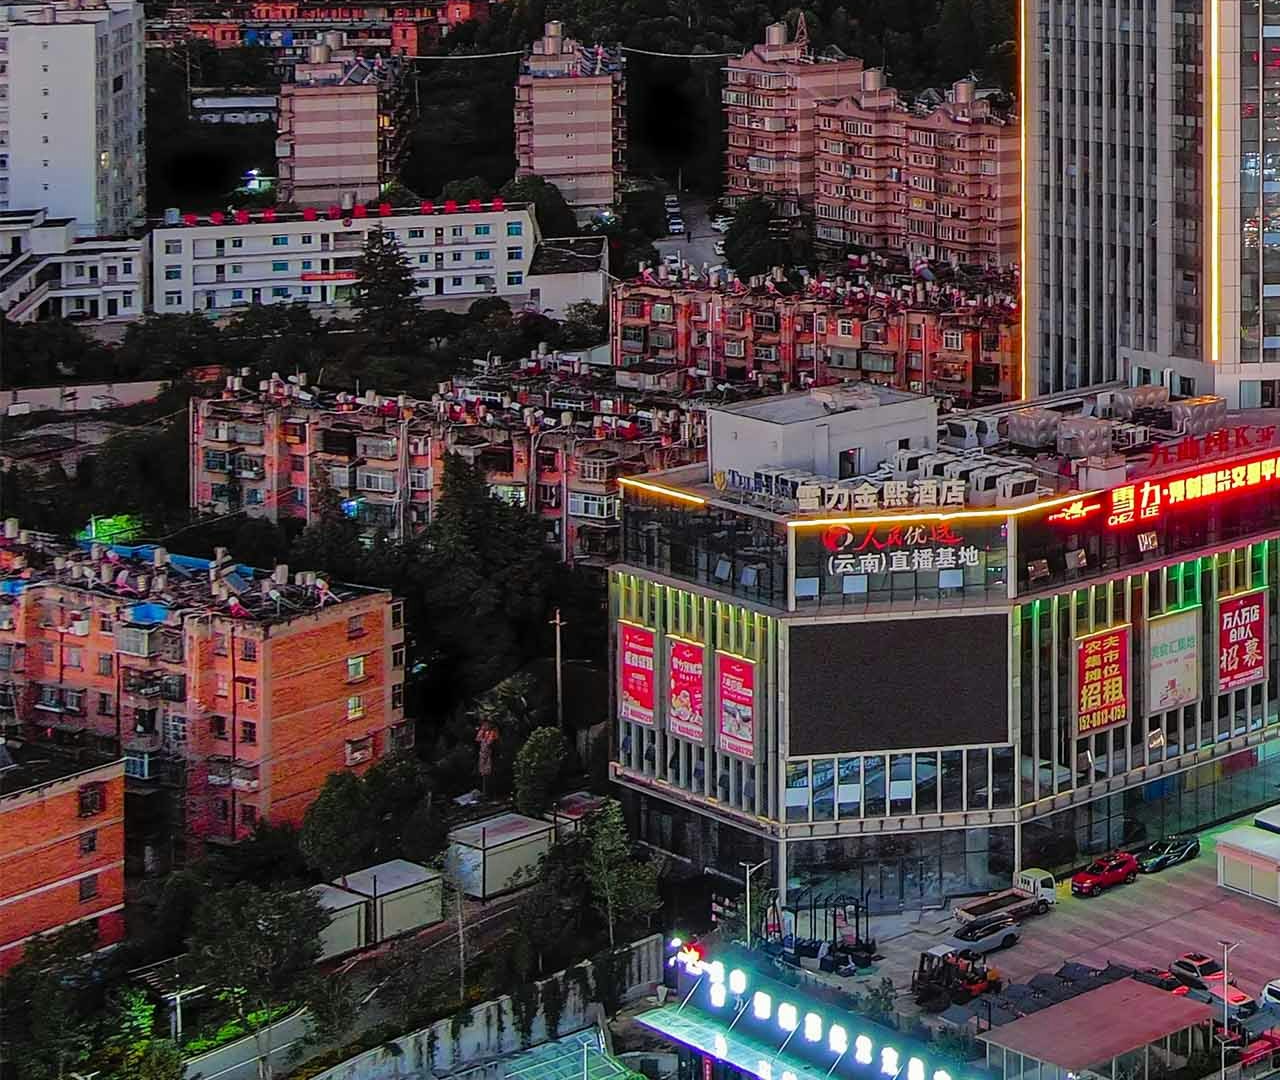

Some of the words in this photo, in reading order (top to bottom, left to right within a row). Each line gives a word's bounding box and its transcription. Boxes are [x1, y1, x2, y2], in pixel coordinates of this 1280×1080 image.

[797, 479, 966, 511] 雪力金熙酒店
[1108, 512, 1135, 526] CHEZ
[1141, 506, 1159, 519] LEE
[828, 545, 979, 575] (云南)直播基地
[1220, 637, 1263, 672] 招募
[1080, 676, 1126, 712] 招租
